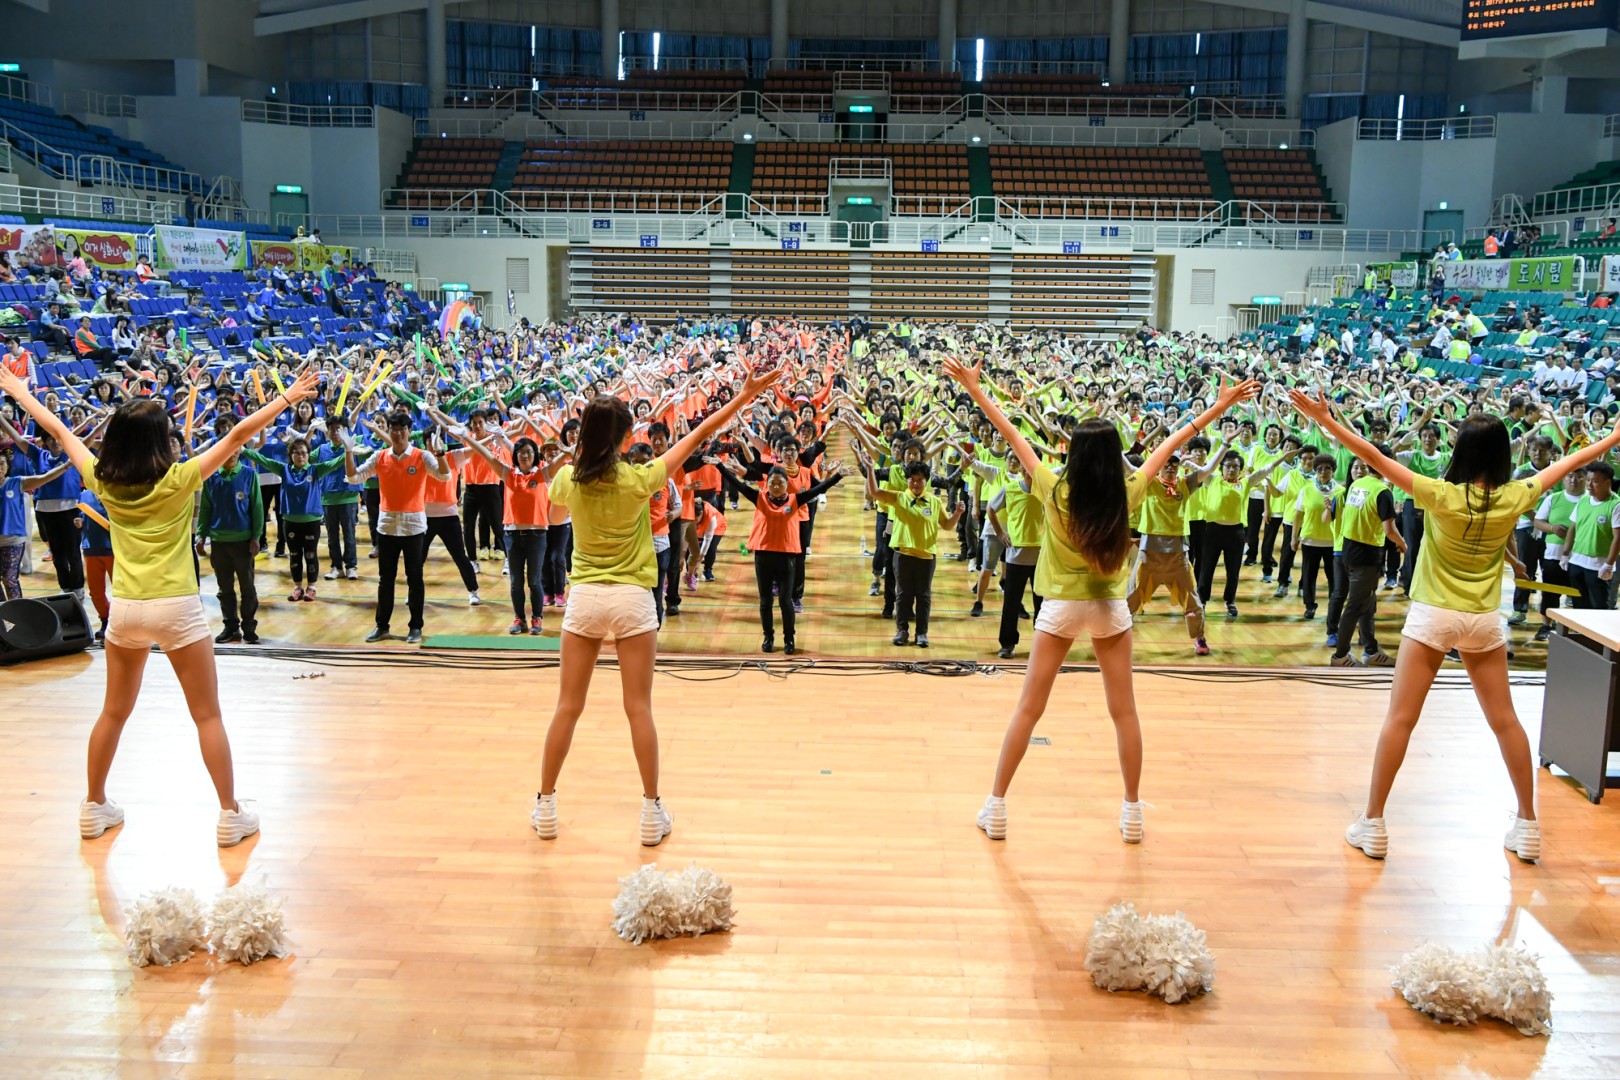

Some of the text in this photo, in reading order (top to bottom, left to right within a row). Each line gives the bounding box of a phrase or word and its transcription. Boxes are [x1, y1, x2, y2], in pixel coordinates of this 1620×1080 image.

[104, 204, 113, 213] 2-5
[84, 242, 98, 253] 이거
[100, 241, 123, 258] 실화냐?
[1518, 260, 1562, 284] 도시팀
